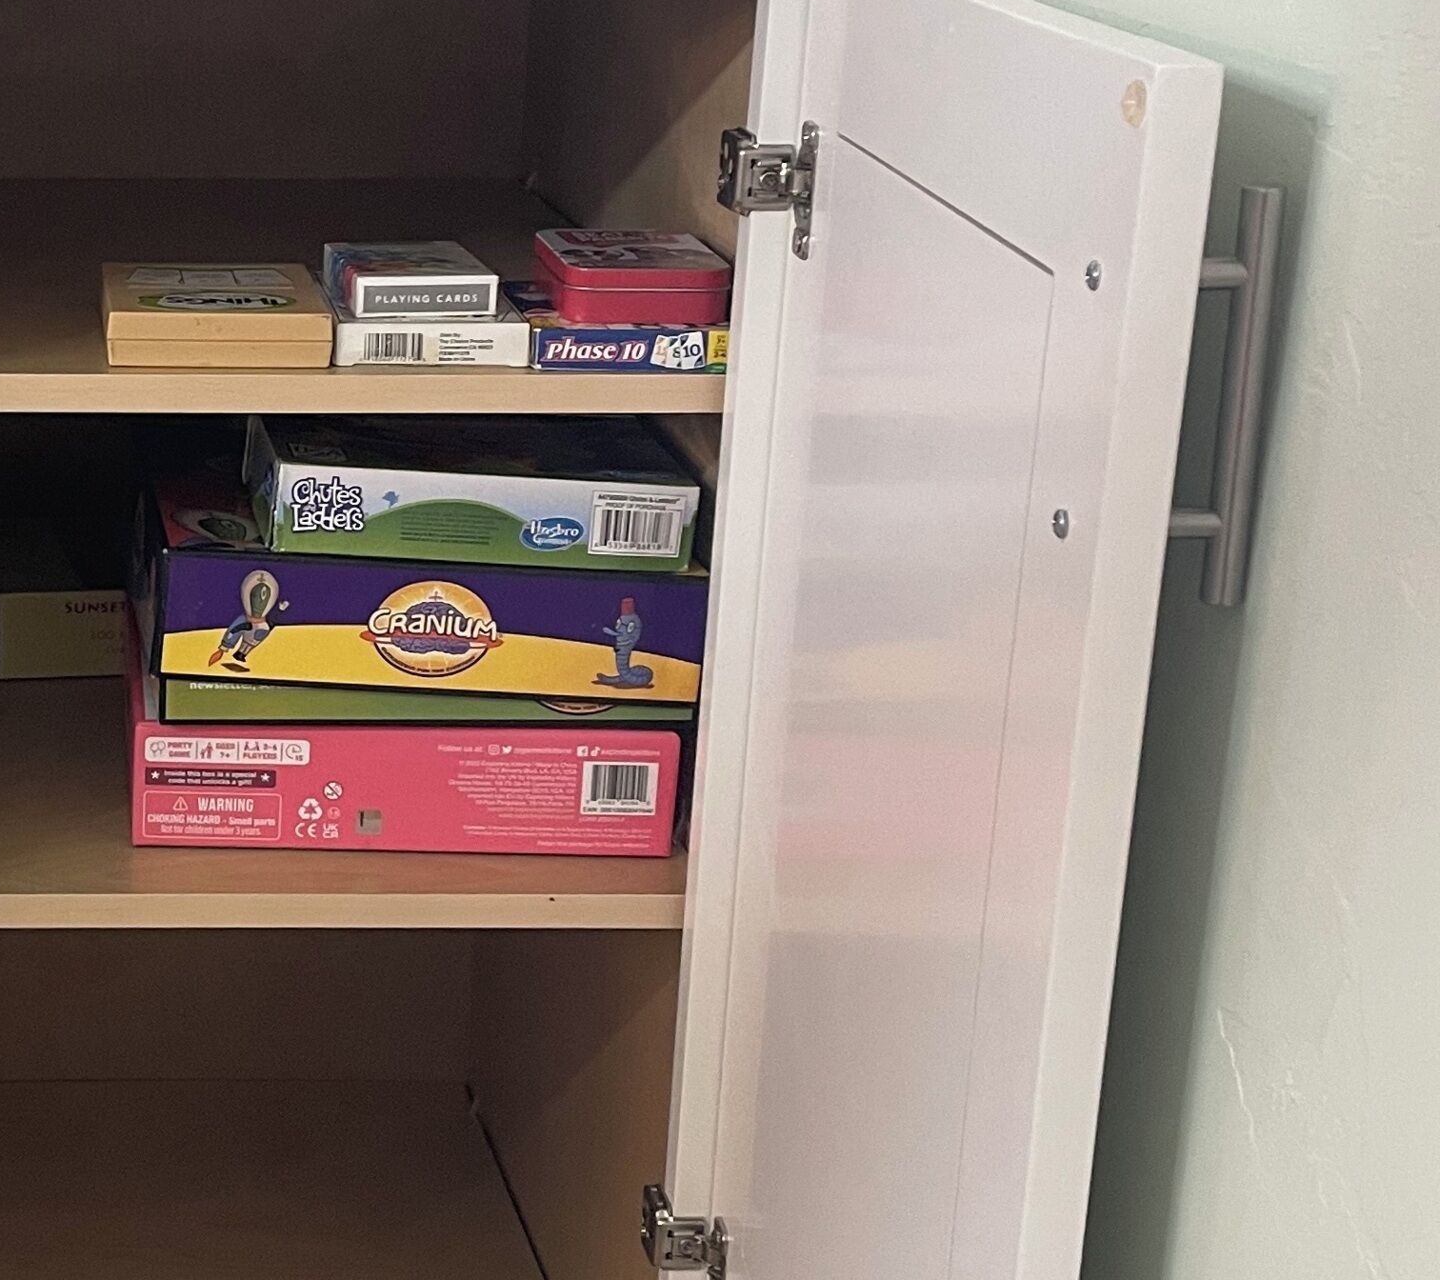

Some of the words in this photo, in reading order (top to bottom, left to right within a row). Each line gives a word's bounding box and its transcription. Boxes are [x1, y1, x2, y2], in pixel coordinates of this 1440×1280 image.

[375, 294, 430, 304] PLAYING
[436, 294, 478, 303] CARDS
[546, 337, 616, 361] Phase
[621, 341, 646, 360] 10
[682, 343, 701, 358] 10
[293, 477, 361, 507] Chutes
[291, 504, 364, 531] Ladders
[530, 520, 579, 538] Hasbro
[243, 752, 277, 760] PLAYERS
[197, 797, 254, 812] WARNING
[147, 814, 185, 824] CHOKING
[186, 815, 220, 825] HAZARD
[228, 817, 252, 825] Small
[253, 818, 276, 827] parts
[160, 825, 173, 833] Not
[184, 825, 213, 834] children
